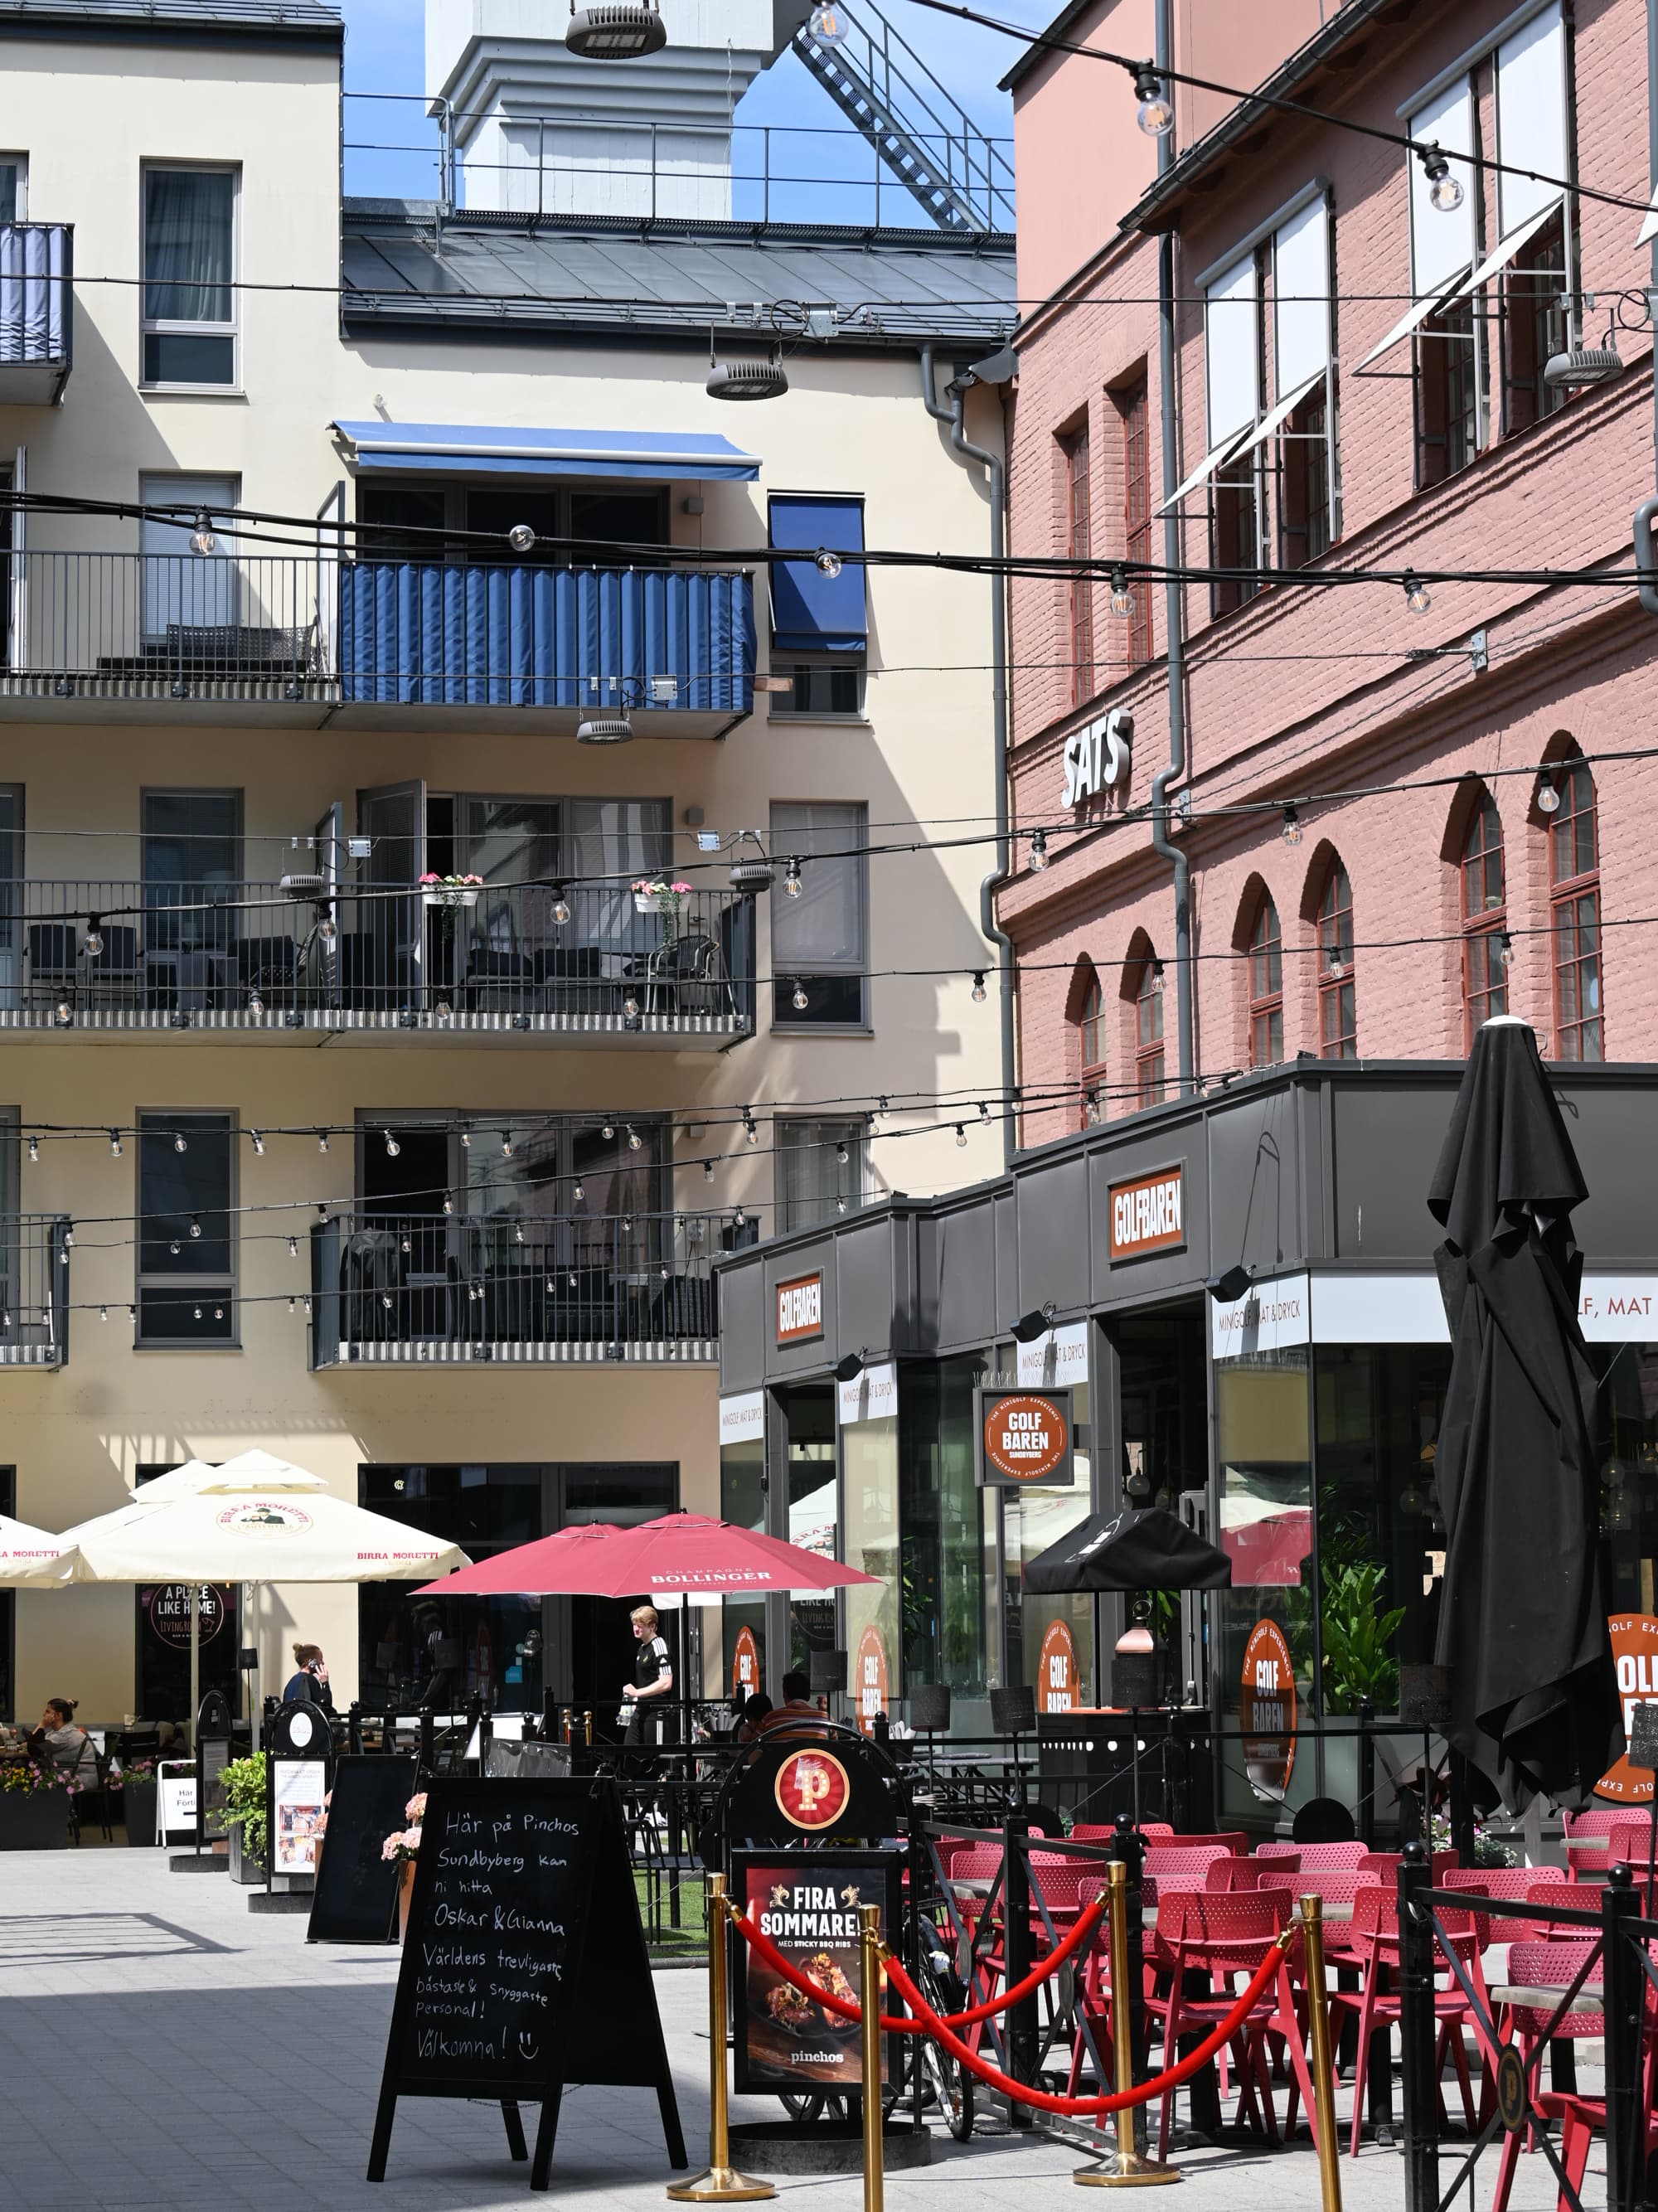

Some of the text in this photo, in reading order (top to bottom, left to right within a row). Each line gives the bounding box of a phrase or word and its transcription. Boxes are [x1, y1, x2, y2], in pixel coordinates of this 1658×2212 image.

[1061, 709, 1124, 808] SATS
[1114, 1179, 1181, 1246] GOLFBAREN
[780, 1283, 821, 1332] GOLFBAREN
[1254, 1304, 1269, 1325] MAT
[1271, 1304, 1277, 1322] &
[1277, 1299, 1301, 1321] DRYCK
[1607, 1297, 1652, 1315] MAT
[1068, 1343, 1086, 1361] DRYCK
[990, 1396, 1060, 1421] THE MINIGOLF EXPERIENCE
[1008, 1412, 1042, 1431] GOLF
[1002, 1432, 1049, 1450] BAREN
[255, 1501, 309, 1523] MORETTI
[651, 1572, 772, 1584] BOLLINGER
[166, 1585, 208, 1599] A PLCE
[158, 1601, 216, 1614] LIKE HME!
[740, 1654, 752, 1681] GOLF
[864, 1656, 878, 1685] GOLF
[1050, 1655, 1068, 1689] GOLF
[1256, 1659, 1279, 1697] GOLF
[446, 1811, 579, 1843] Här på Pinchos
[437, 1848, 525, 1872] Sundbyberg
[434, 1880, 492, 1895] ni hitta
[793, 1886, 837, 1910] FIRA
[435, 1904, 488, 1927] Oskar
[424, 1943, 486, 1966] Världens
[819, 1940, 834, 1949] BBQ
[790, 2050, 844, 2064] pinchos
